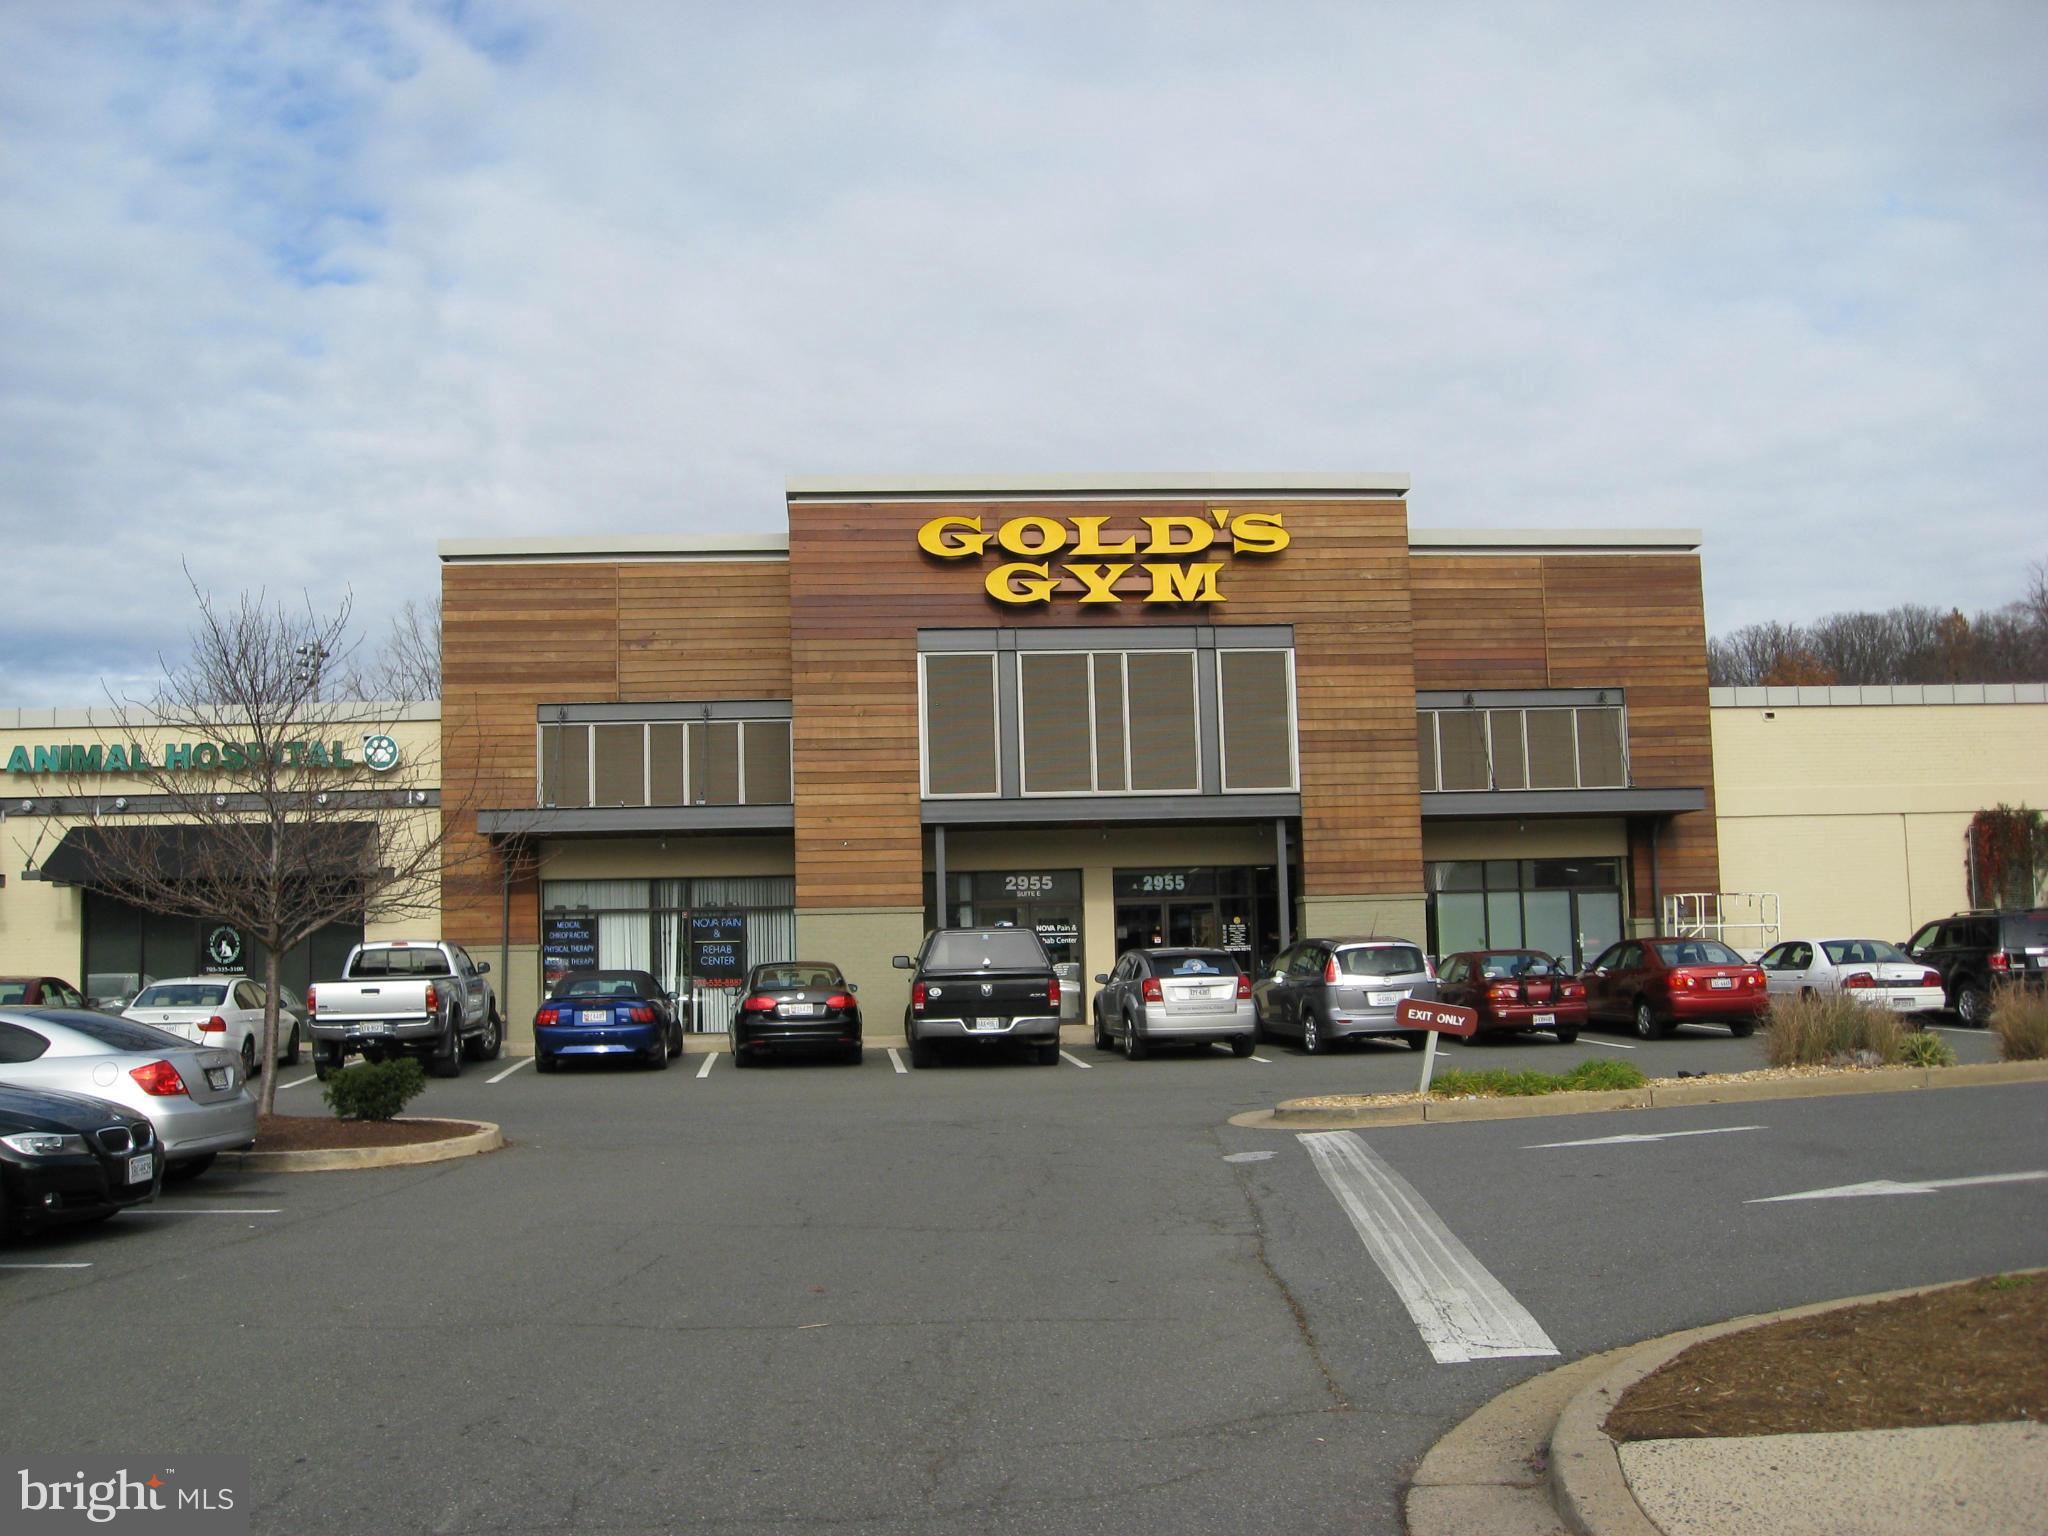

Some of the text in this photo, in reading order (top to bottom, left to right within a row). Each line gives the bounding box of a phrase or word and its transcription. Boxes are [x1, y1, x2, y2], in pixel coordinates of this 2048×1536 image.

[917, 509, 1291, 557] GOLD'S
[984, 561, 1228, 603] GYM
[6, 743, 150, 772] ANIMAL
[1005, 876, 1053, 890] 2955
[1143, 875, 1185, 890] 2955
[556, 921, 580, 929] MEDICAL
[692, 918, 742, 928] NOVA PAIN
[549, 931, 589, 940] CHIROPRACTIC
[713, 928, 721, 938] &
[544, 944, 595, 953] PHYSICAL THERAPY
[702, 945, 732, 955] REHAB
[571, 958, 594, 966] THERAPY
[700, 956, 735, 966] CENTER
[1408, 1009, 1465, 1026] EXIT ONLY
